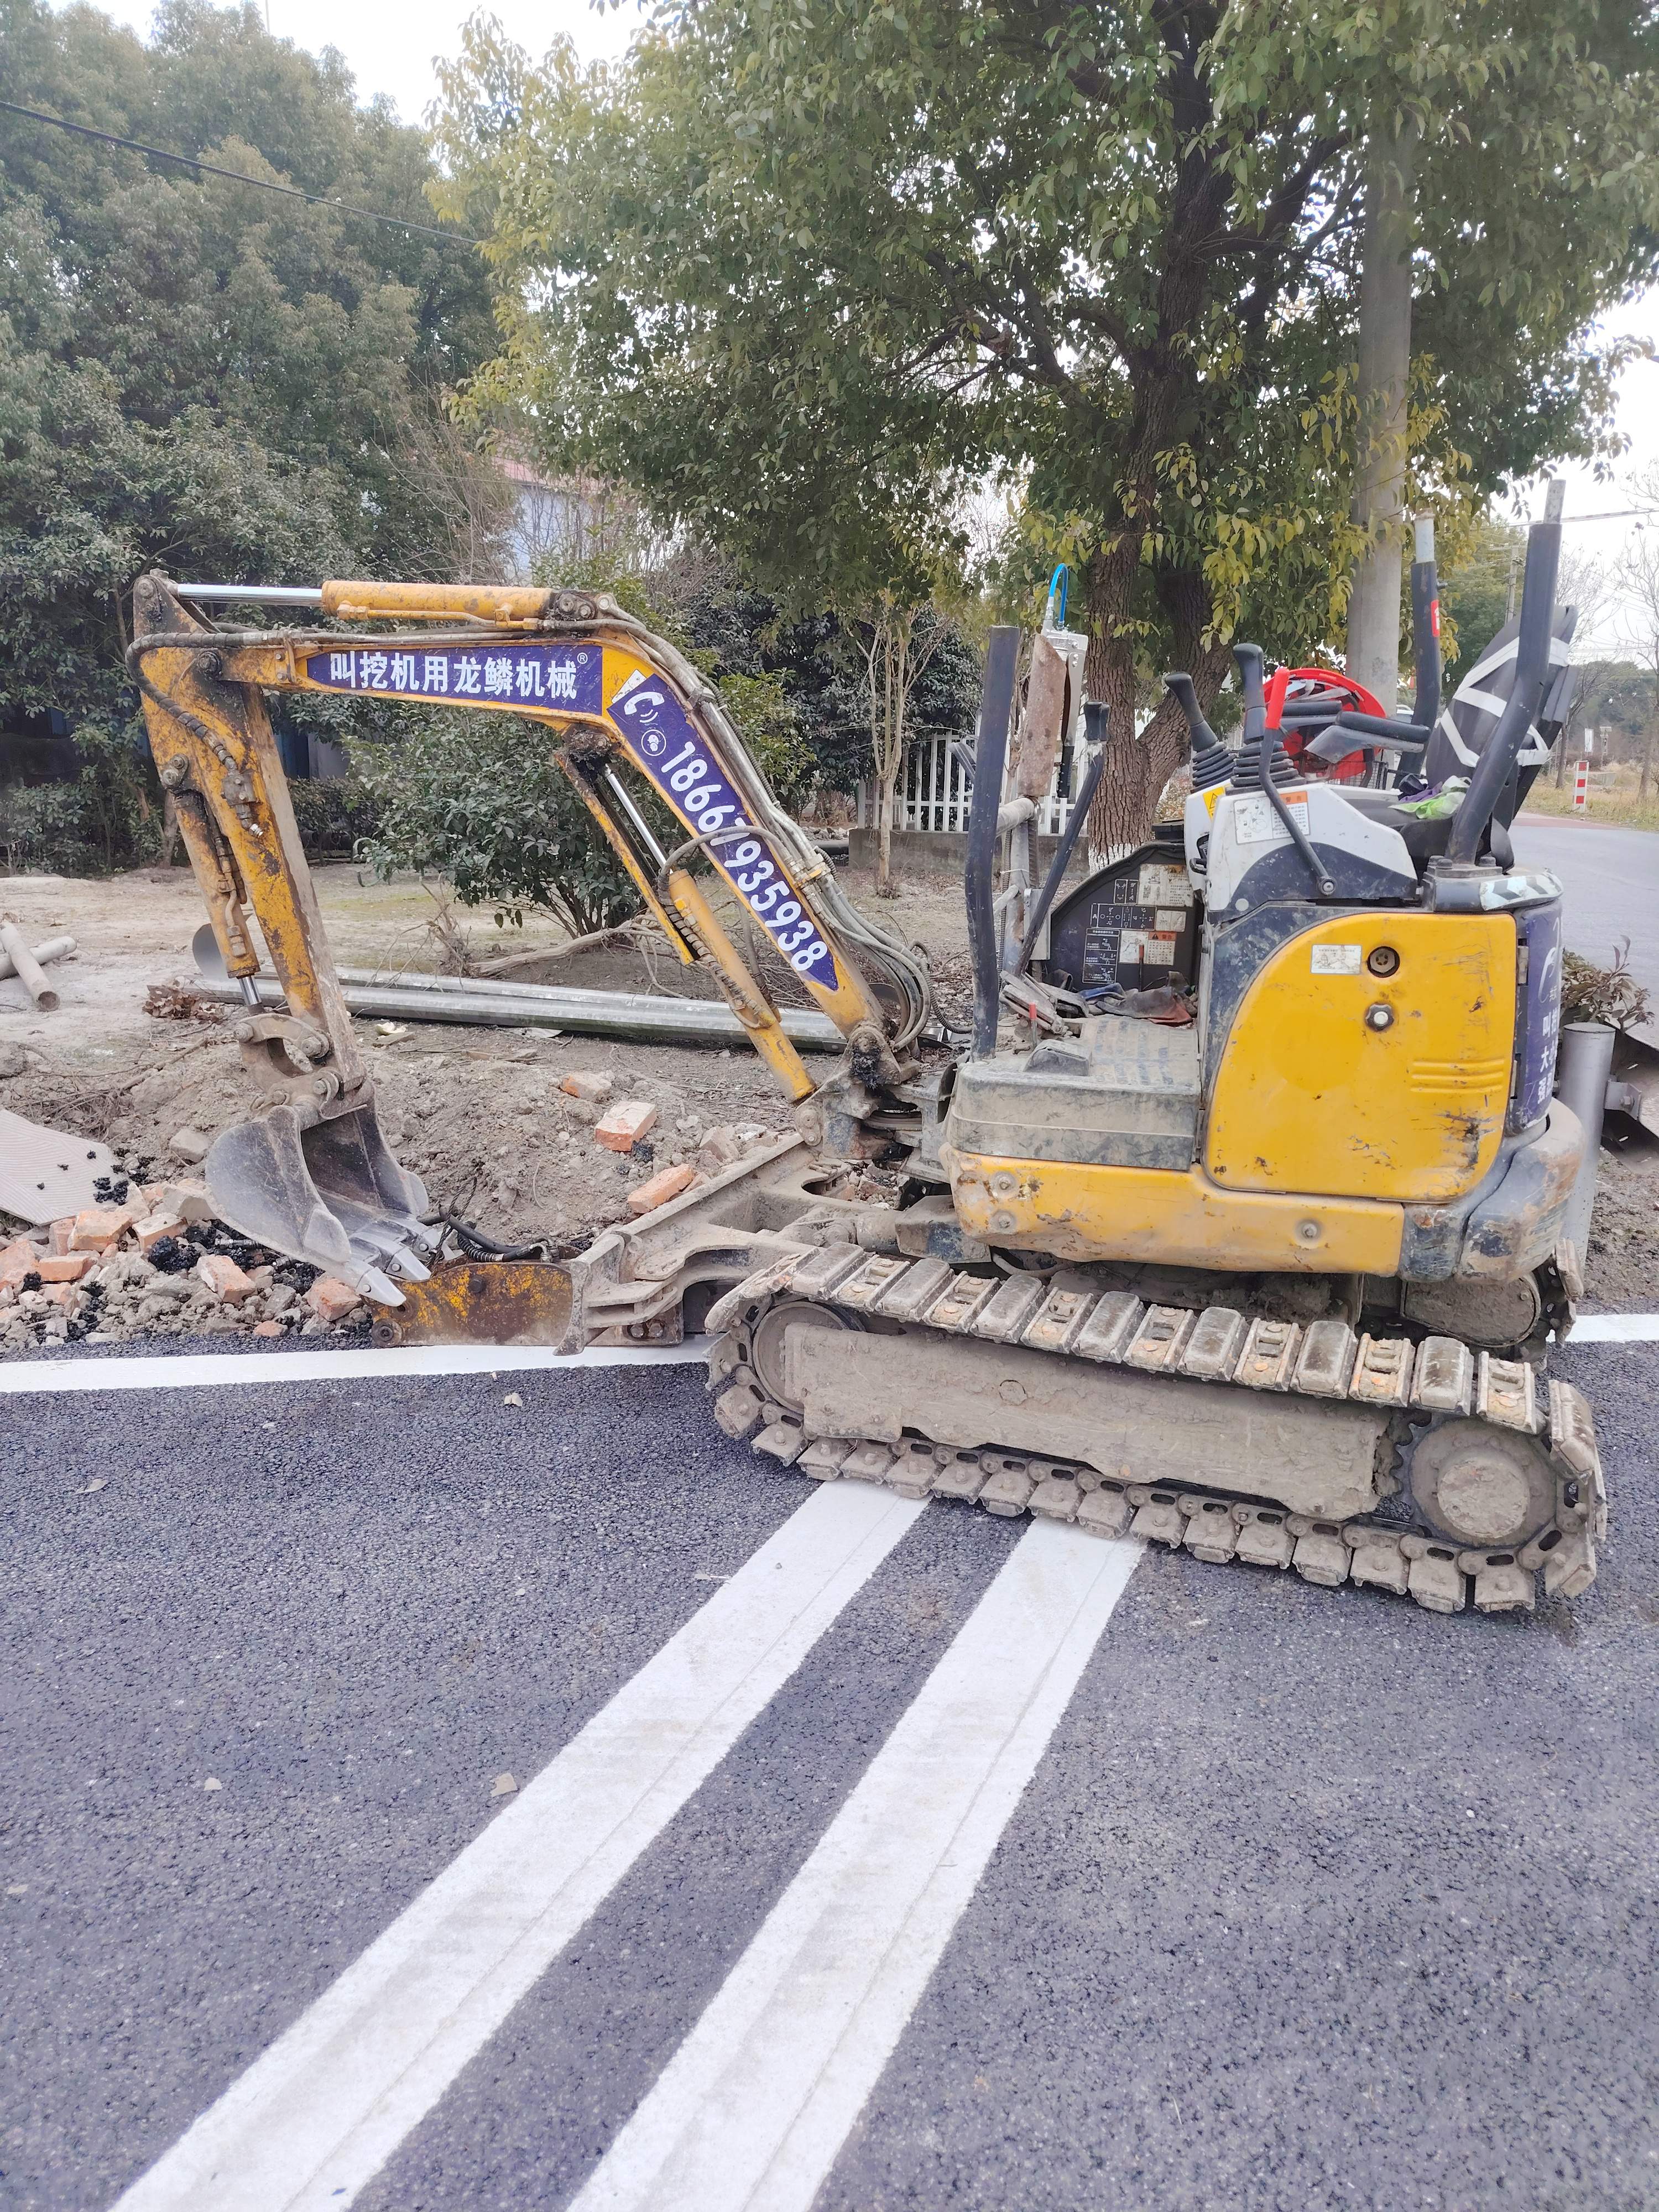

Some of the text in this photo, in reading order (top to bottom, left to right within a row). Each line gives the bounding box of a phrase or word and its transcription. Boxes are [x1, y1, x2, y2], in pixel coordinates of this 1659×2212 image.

[331, 651, 577, 699] 叫挖机用龙鳞机械
[661, 741, 828, 971] 18667935938
